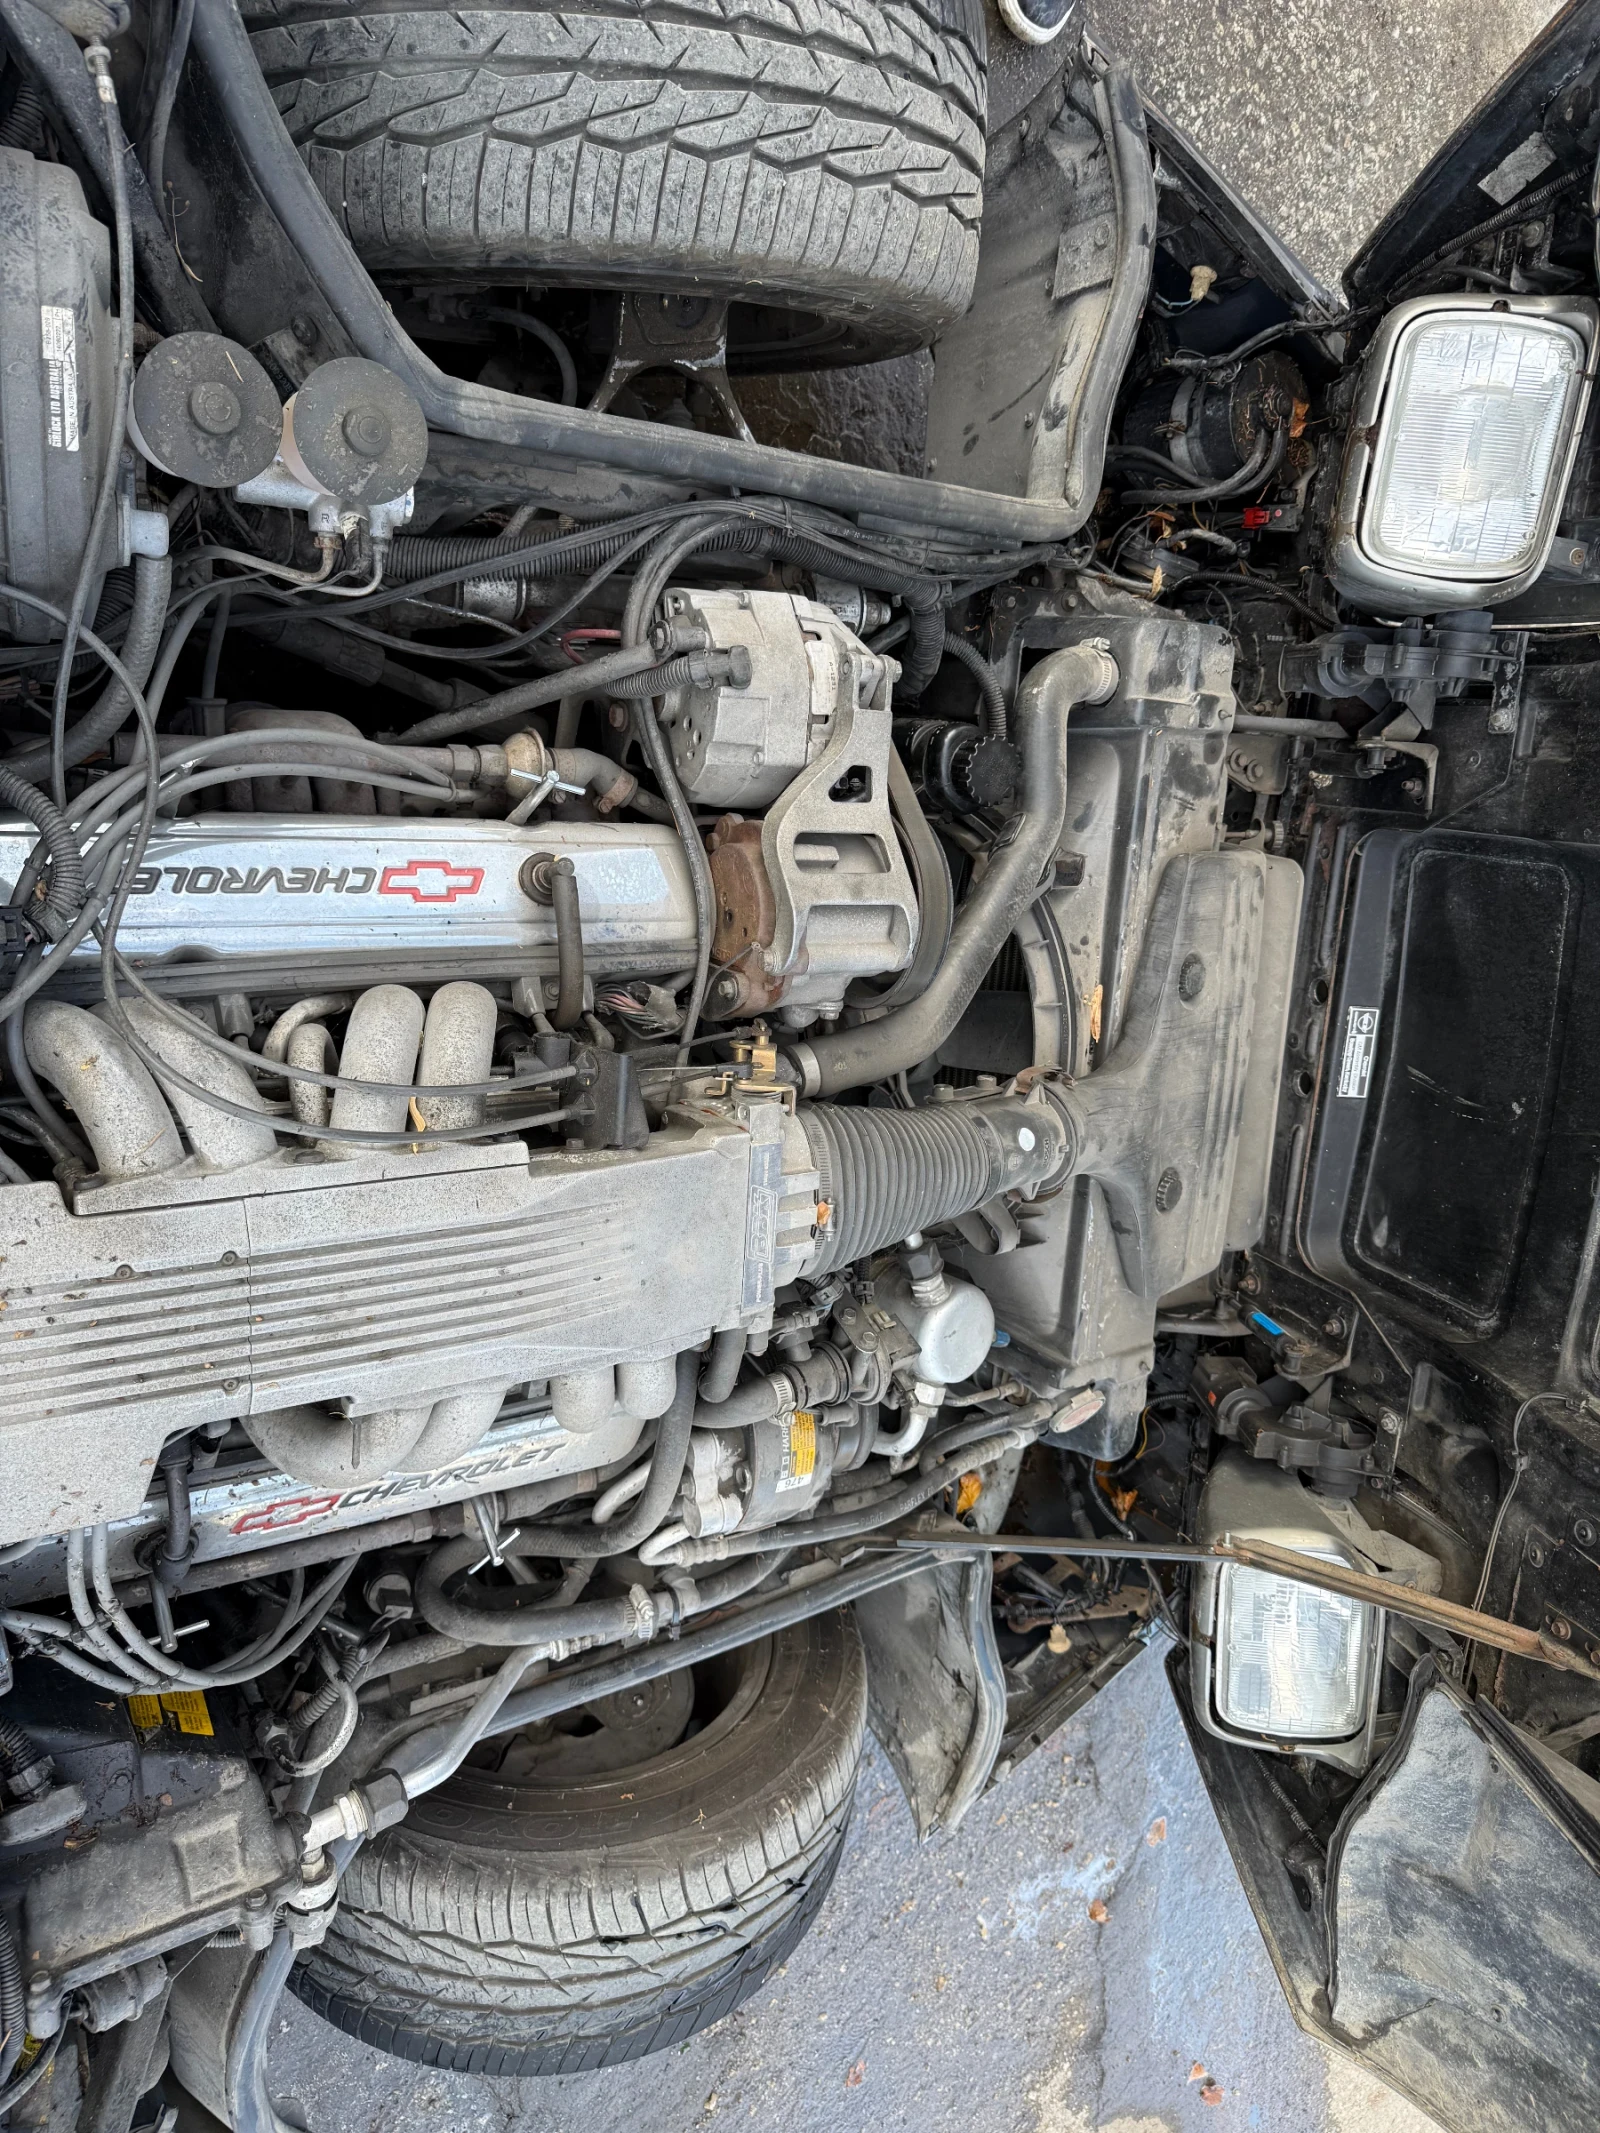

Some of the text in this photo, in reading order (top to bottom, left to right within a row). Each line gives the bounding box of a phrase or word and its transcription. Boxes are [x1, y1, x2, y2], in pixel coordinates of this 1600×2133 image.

[48, 360, 61, 400] AUSTRALIA
[50, 400, 61, 416] LTD
[51, 416, 62, 448] GIRLOCK
[111, 866, 376, 895] CHEVROLE
[339, 1443, 567, 1508] CHEVROLET
[785, 1476, 805, 1489] 476
